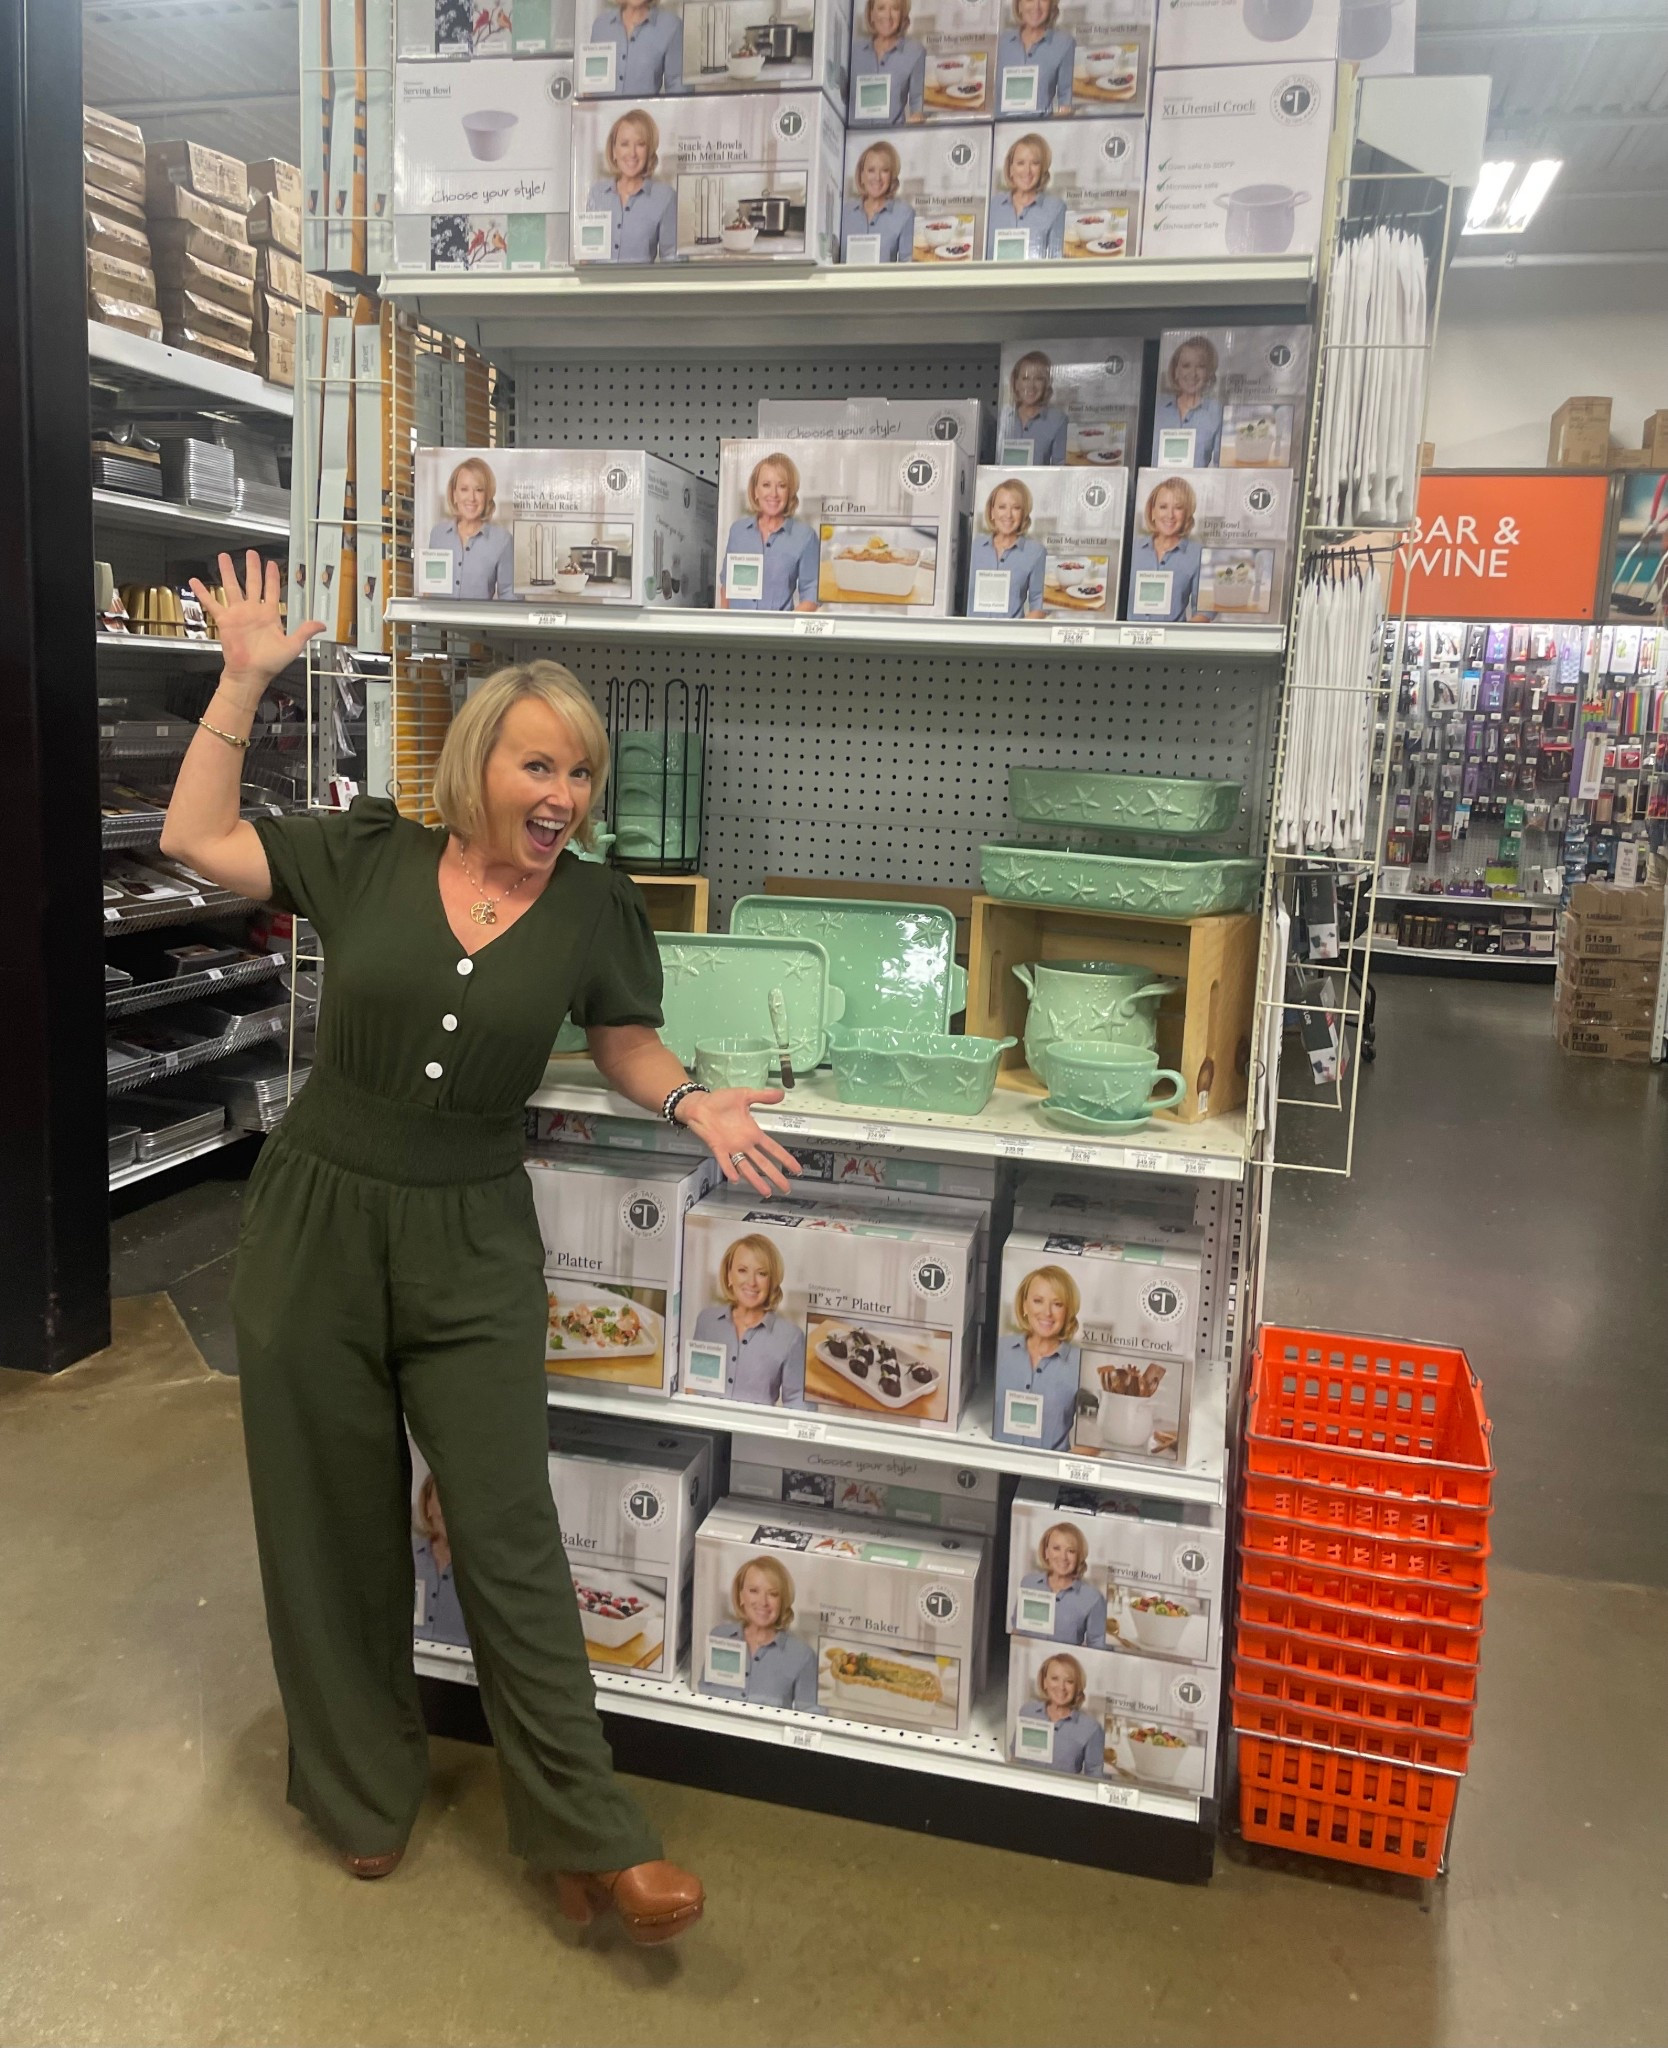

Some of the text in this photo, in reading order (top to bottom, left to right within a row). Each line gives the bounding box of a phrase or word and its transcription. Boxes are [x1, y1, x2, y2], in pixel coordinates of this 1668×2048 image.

[403, 85, 451, 97] Serving Bowl
[1162, 100, 1256, 116] XL Utensil Crock
[677, 150, 748, 162] with Metal Rack
[431, 180, 546, 204] Choose your style!
[787, 420, 902, 440] Choose your style!
[513, 500, 579, 511] with Metal Rack
[821, 502, 866, 514] Loaf Pan
[1223, 530, 1258, 540] Spreader
[1400, 515, 1520, 546] BAR &
[1064, 538, 1080, 547] Mug
[1080, 538, 1096, 546] with
[1398, 548, 1510, 578] WINE
[1585, 934, 1612, 944] 5139
[1572, 1032, 1600, 1042] 5139
[557, 1252, 603, 1270] Platter
[808, 1284, 841, 1293] Stoneware
[825, 1297, 832, 1306] x
[836, 1296, 848, 1307] 7"
[852, 1298, 892, 1314] Platter
[1082, 1330, 1173, 1352] XL Utensil Crock
[808, 1454, 918, 1476] Choose your style!
[560, 1532, 598, 1548] Baker
[1108, 1566, 1161, 1581] Serving Bowl
[838, 1617, 845, 1625] x
[848, 1616, 861, 1626] 7"
[864, 1618, 900, 1634] Baker
[1106, 1696, 1159, 1712] Serving Bowl
